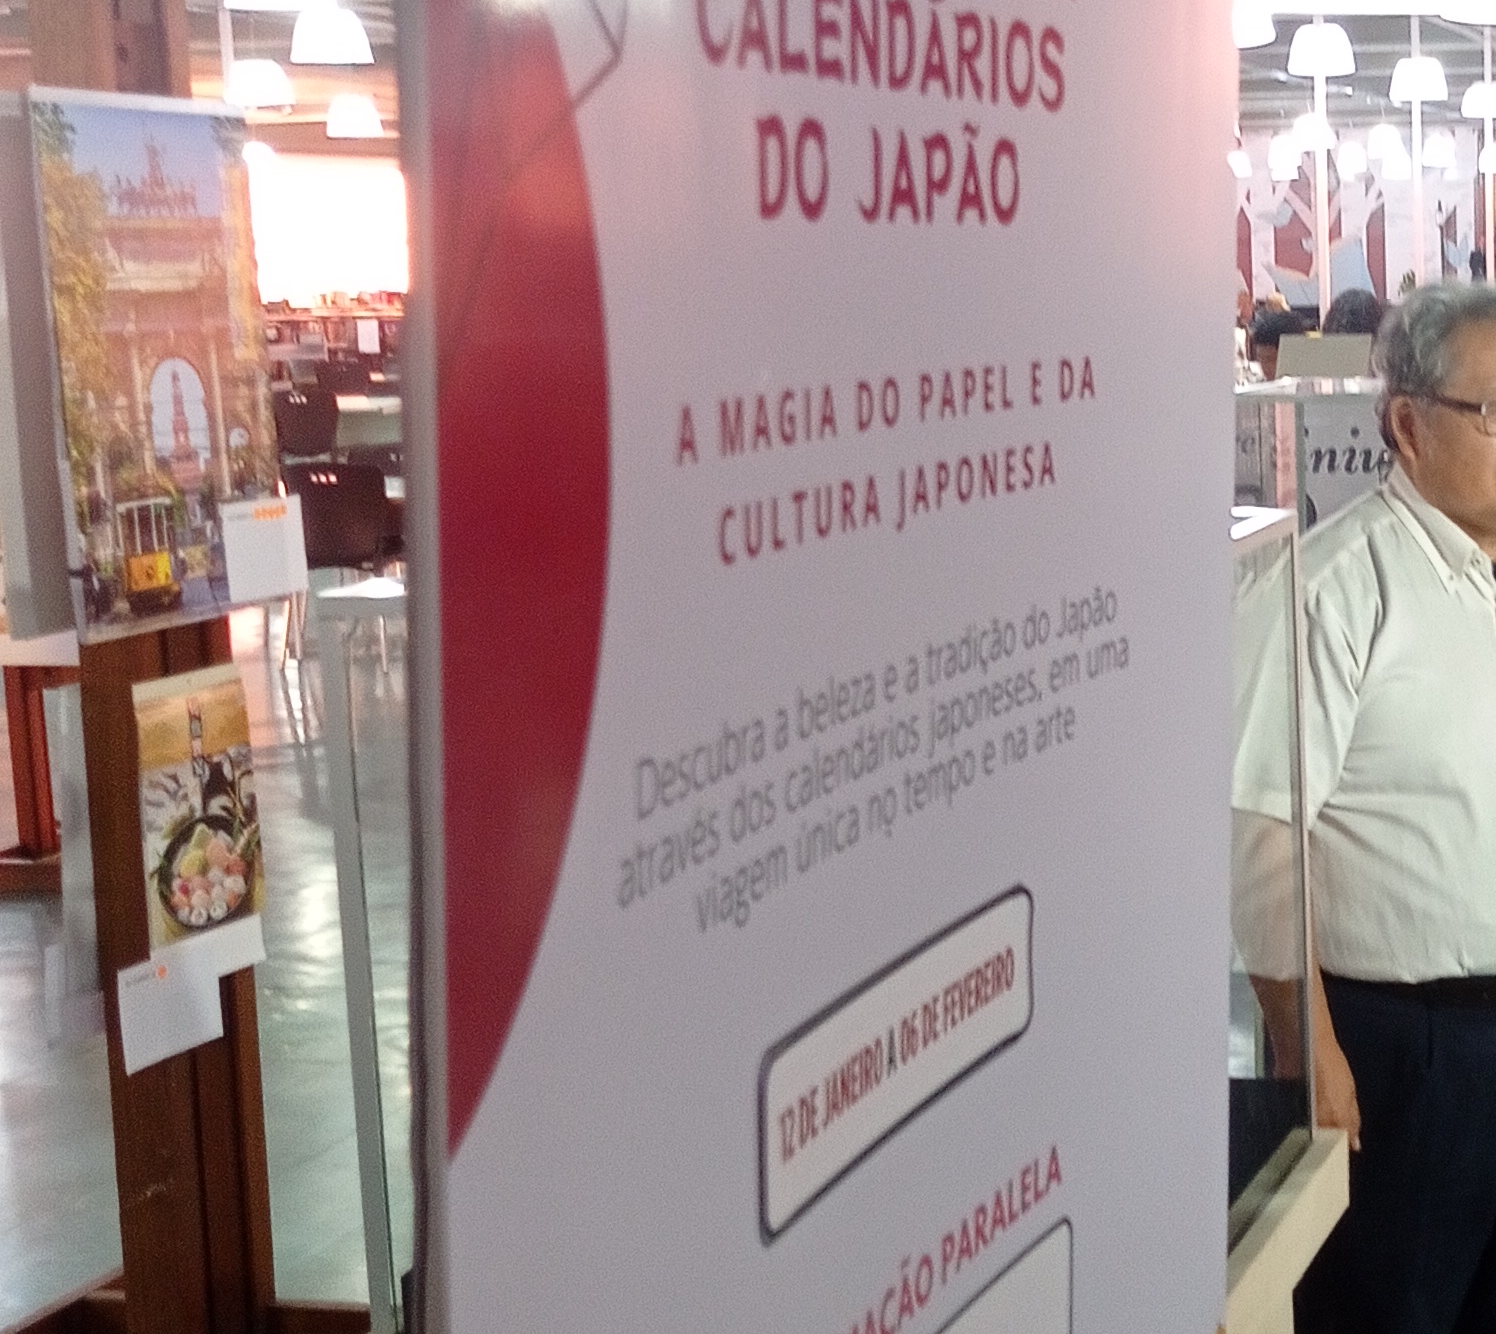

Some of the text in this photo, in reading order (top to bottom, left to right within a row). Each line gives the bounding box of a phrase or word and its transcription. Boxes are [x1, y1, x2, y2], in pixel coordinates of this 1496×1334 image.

[756, 114, 1021, 226] DO JAPÃO
[676, 355, 1096, 467] A MAGIA DO PAPEL E DA
[718, 440, 1057, 567] CULTURA JAPONESA
[616, 636, 1130, 910] através dos calendários japoneses, em uma
[638, 585, 1117, 821] Descubra a beleza e a tradição do Japão
[796, 803, 861, 874] única
[867, 786, 898, 835] no
[903, 749, 976, 814] tempo
[981, 739, 997, 776] e
[1002, 725, 1029, 766] na
[1035, 705, 1076, 754] arte
[778, 945, 1015, 1164] 12 DE JANEIRO A 06 DE FEVEREIRO
[940, 1144, 1063, 1285] PARALELA
